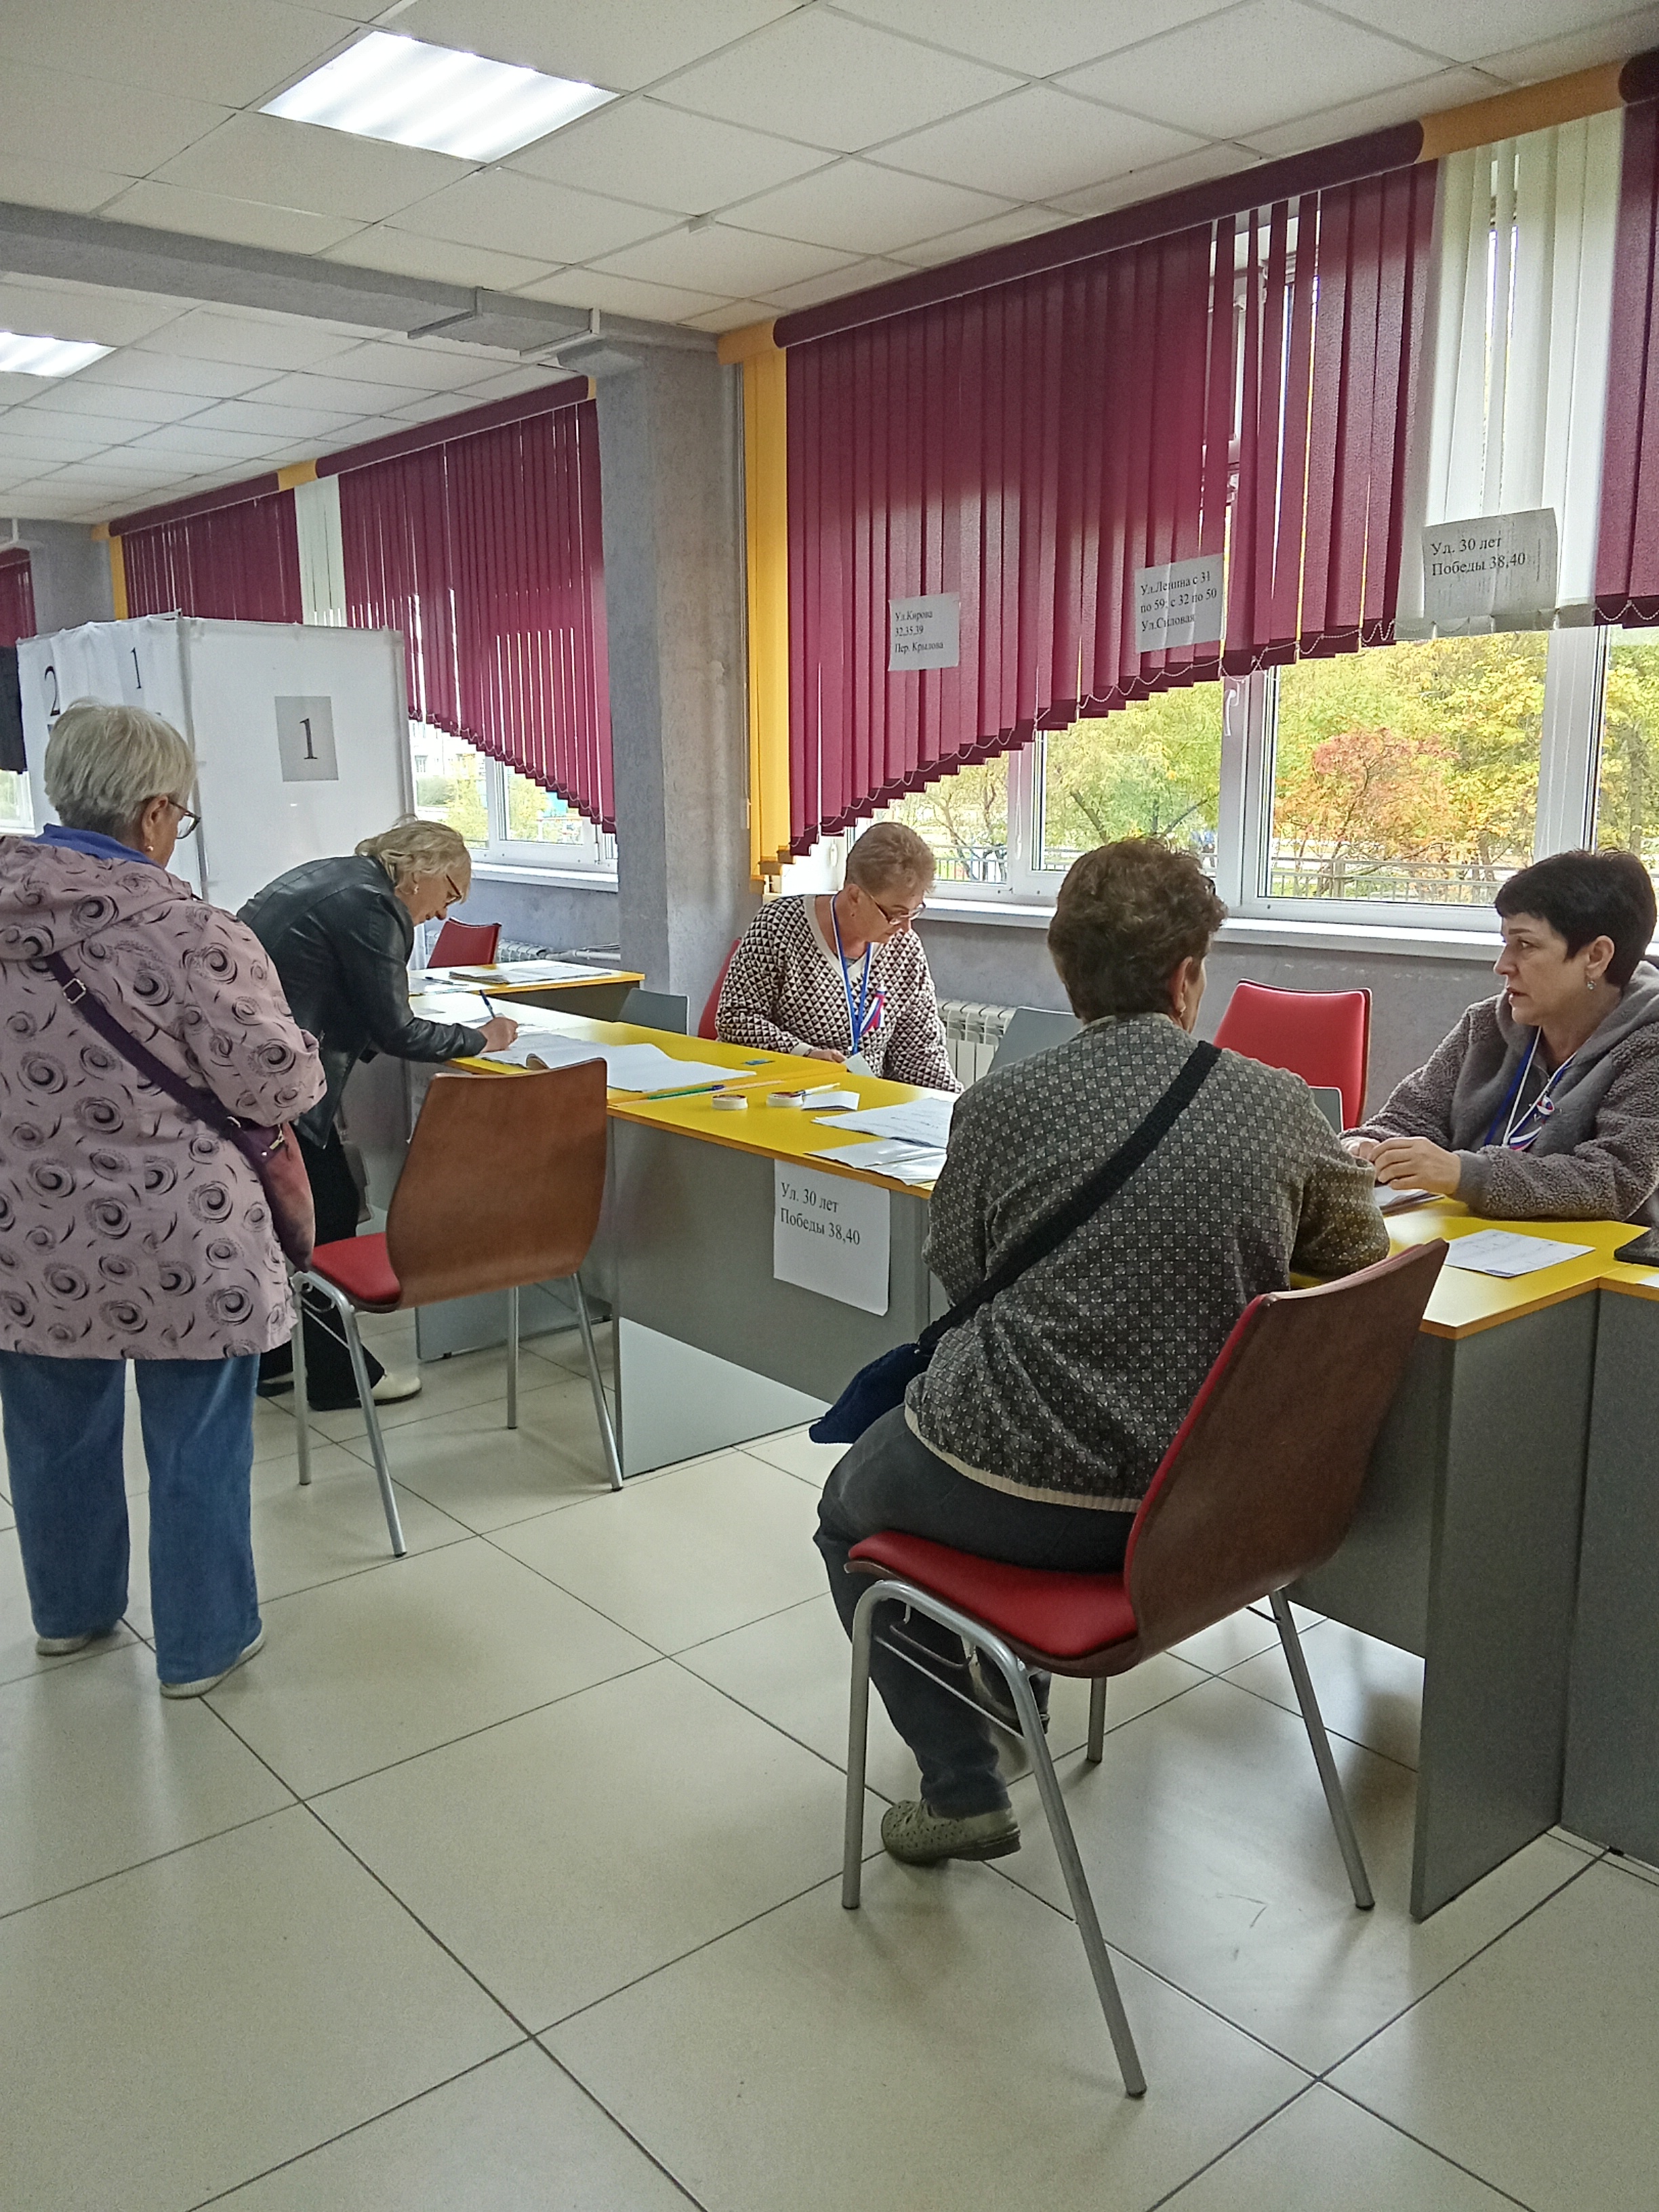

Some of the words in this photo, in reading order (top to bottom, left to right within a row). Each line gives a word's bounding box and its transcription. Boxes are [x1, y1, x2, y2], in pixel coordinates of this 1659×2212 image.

[1430, 542, 1455, 556] Ул.
[1459, 539, 1476, 552] 30
[1479, 537, 1502, 549] лет
[1193, 576, 1198, 585] с
[1200, 571, 1210, 583] 31
[1431, 560, 1487, 576] Победы
[1490, 552, 1525, 570] 38,40
[1141, 604, 1151, 613] по
[1170, 598, 1176, 607] с
[1178, 594, 1189, 606] 32
[1191, 594, 1203, 603] по
[1206, 588, 1217, 600] 50
[895, 643, 910, 654] Пер.
[912, 642, 943, 653] Крылова
[130, 647, 142, 689] 1
[44, 665, 61, 716] 2
[298, 718, 319, 760] 1
[781, 1182, 799, 1202] Ул.
[802, 1189, 817, 1206] 30
[819, 1197, 838, 1213] лет
[780, 1208, 825, 1235] Победы
[828, 1223, 860, 1246] 38,40
